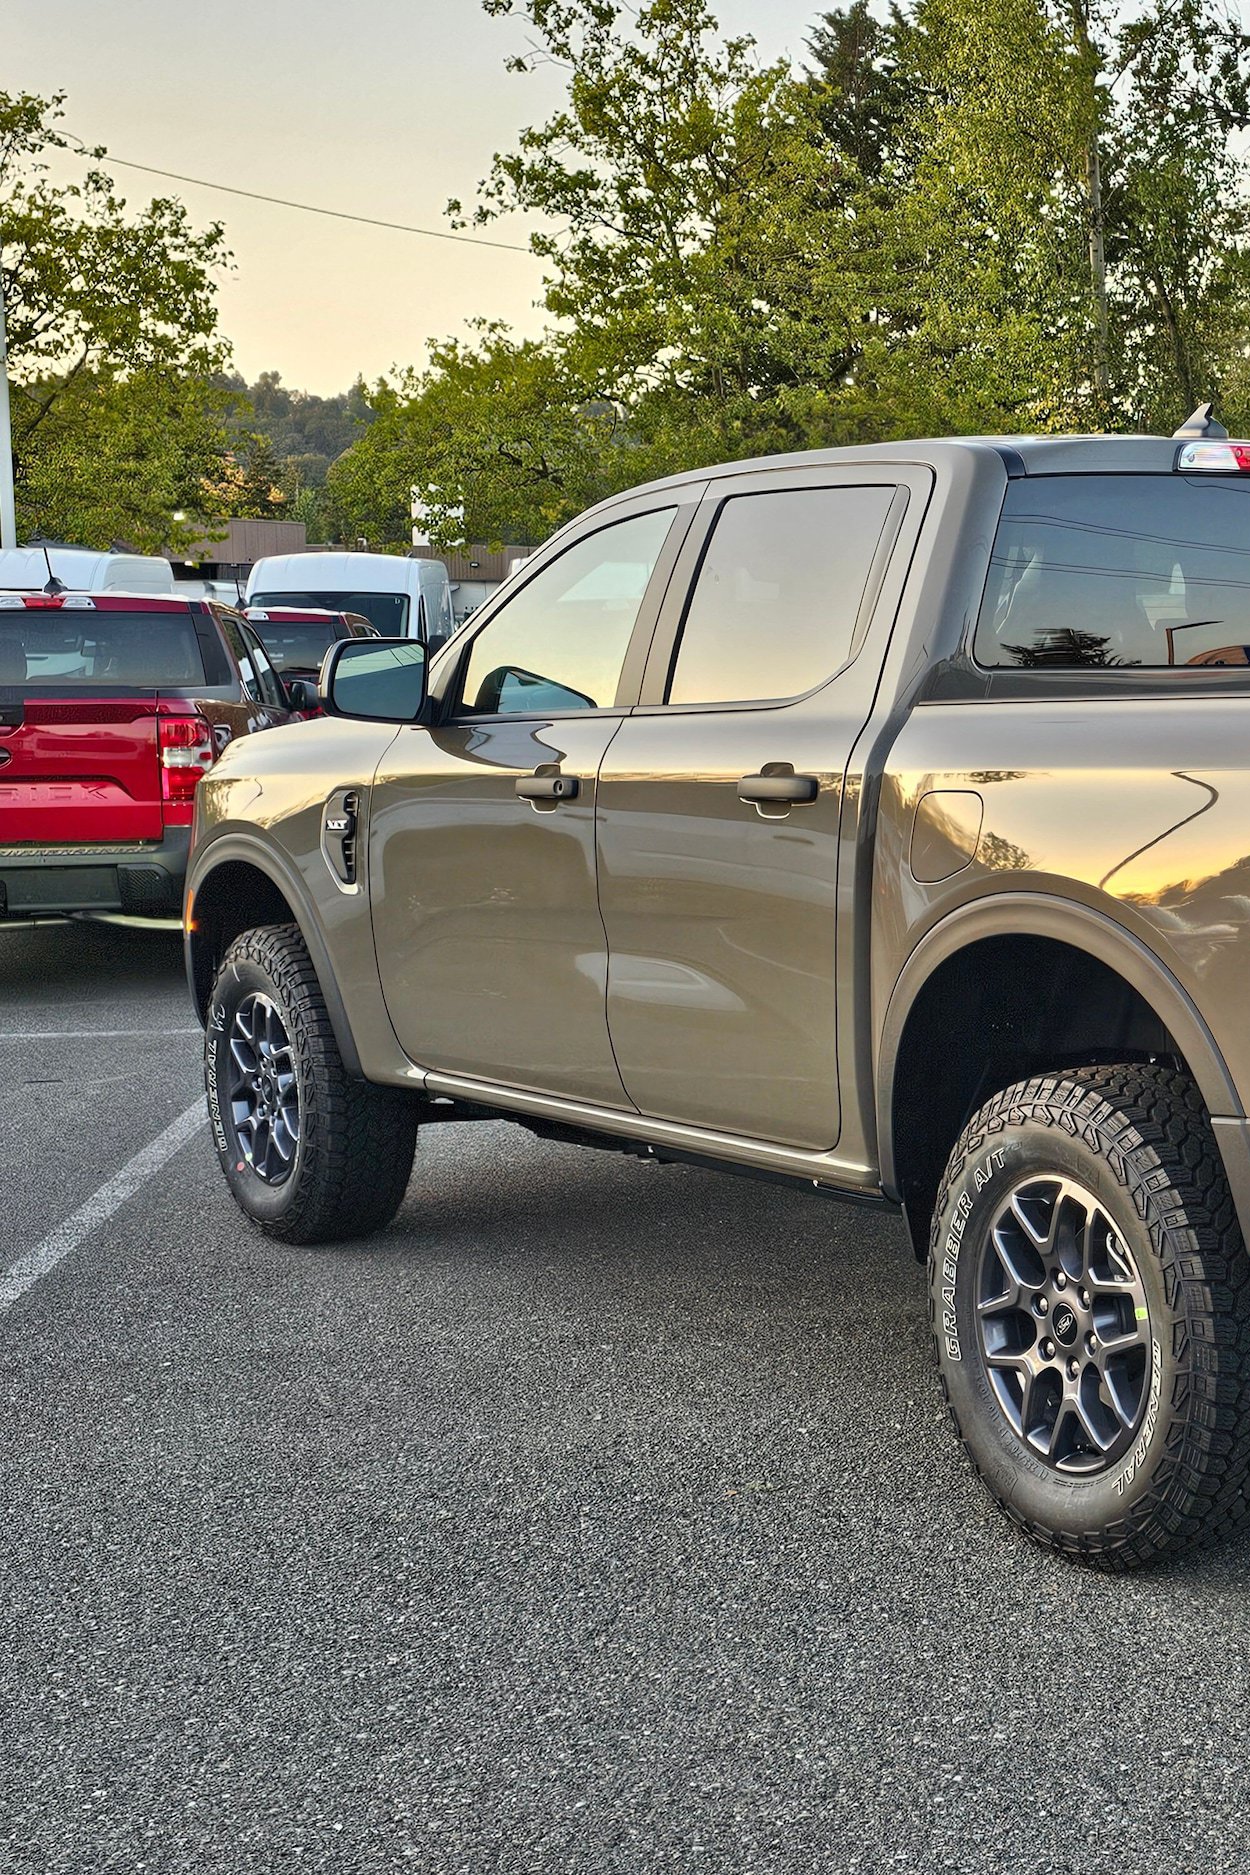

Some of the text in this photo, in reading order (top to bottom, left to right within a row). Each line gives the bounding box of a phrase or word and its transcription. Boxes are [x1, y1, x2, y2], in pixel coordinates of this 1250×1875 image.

[207, 1039, 228, 1152] GENERAL
[942, 1190, 974, 1362] GRABBER
[1111, 1337, 1162, 1496] GENERAL
